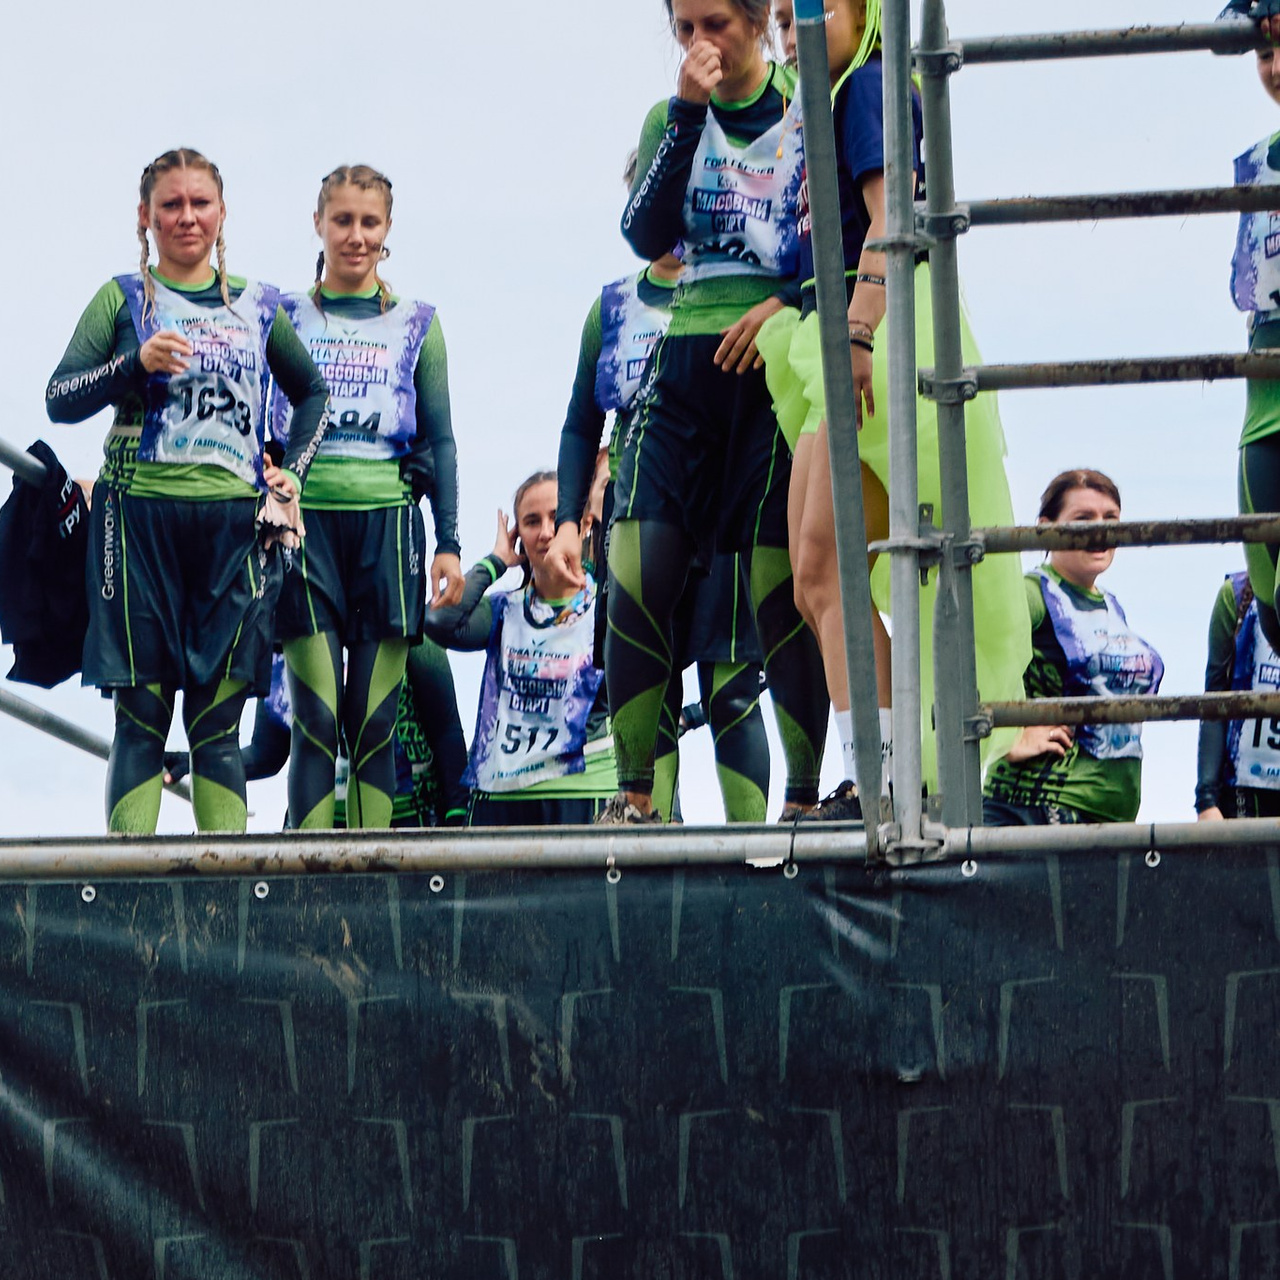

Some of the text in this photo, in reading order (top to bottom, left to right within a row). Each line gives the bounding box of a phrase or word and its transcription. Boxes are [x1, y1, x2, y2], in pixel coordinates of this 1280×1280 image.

[623, 132, 675, 230] Greenway
[190, 339, 256, 370] АССОВЫЙ
[317, 363, 386, 384] АССОВЫЙ
[47, 358, 119, 400] Greenway
[101, 505, 116, 601] Greenway
